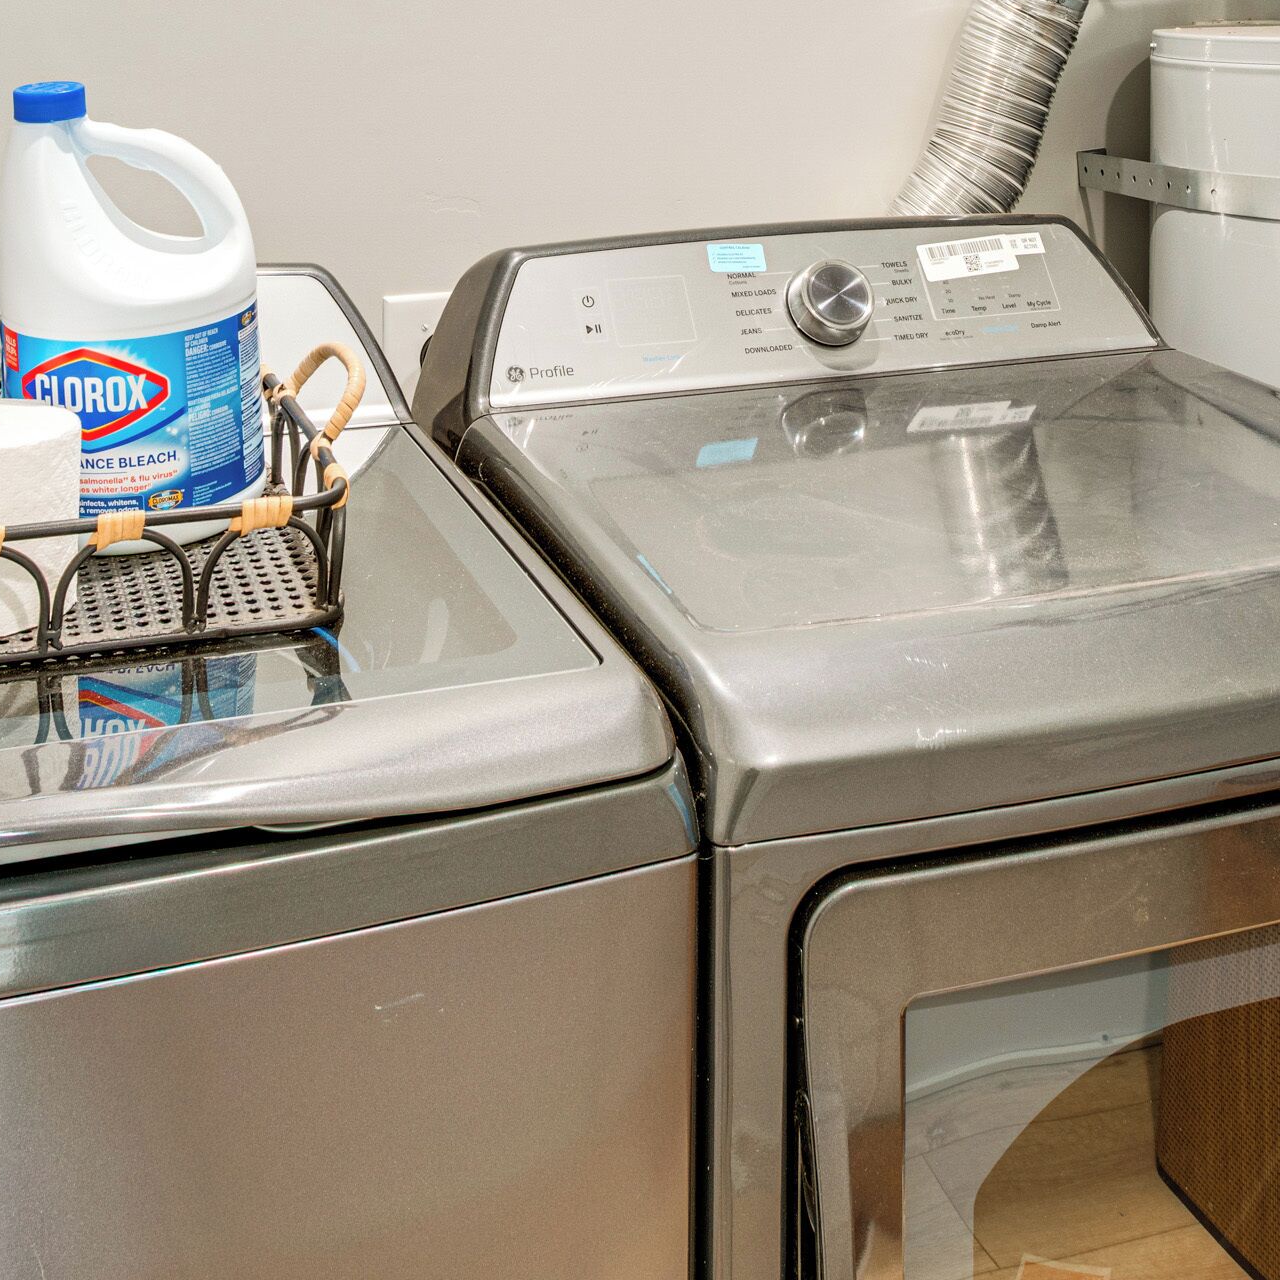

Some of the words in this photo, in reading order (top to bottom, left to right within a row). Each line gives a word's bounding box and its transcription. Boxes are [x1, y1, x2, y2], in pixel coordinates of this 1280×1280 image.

[881, 261, 908, 269] TOWELS
[727, 272, 757, 280] NORMAL
[731, 290, 754, 298] MIXED
[754, 288, 777, 296] LOADS
[1026, 300, 1035, 308] My
[1036, 299, 1052, 307] Cycle
[736, 307, 772, 317] DELICATES
[893, 314, 923, 322] SANITIZE
[1048, 320, 1062, 328] Alert
[740, 327, 763, 335] JEANS
[894, 333, 915, 341] TIMED
[744, 344, 793, 354] DOWNLOADED
[529, 366, 575, 379] Profile
[35, 373, 149, 413] CLOROX
[119, 450, 178, 468] BLEACH
